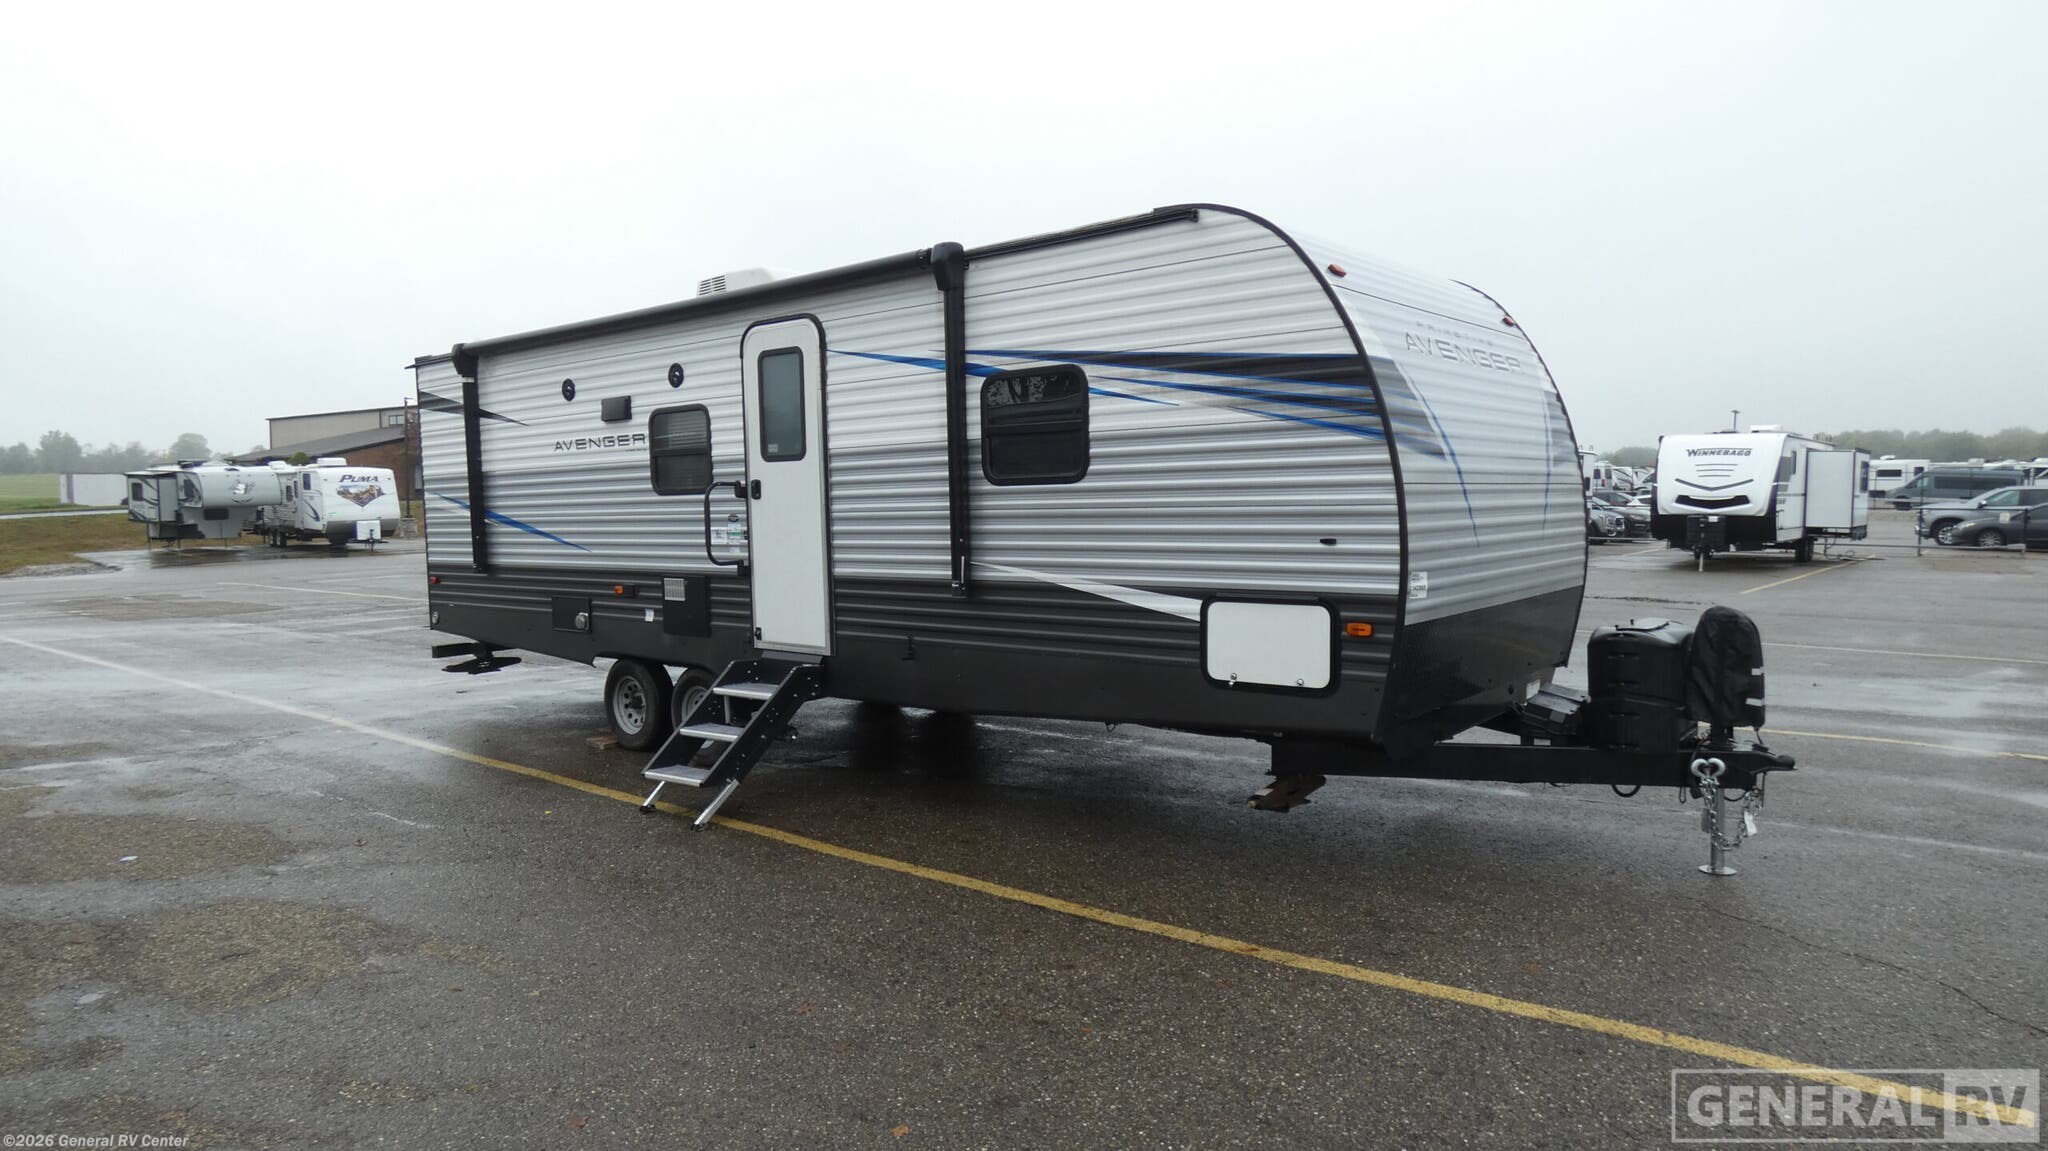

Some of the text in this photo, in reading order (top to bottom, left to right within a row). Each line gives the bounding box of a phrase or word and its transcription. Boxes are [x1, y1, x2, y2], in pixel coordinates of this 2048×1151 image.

[554, 433, 646, 452] AVENGER
[1686, 448, 1752, 457] WINNEBAGO
[339, 474, 379, 483] PUMA
